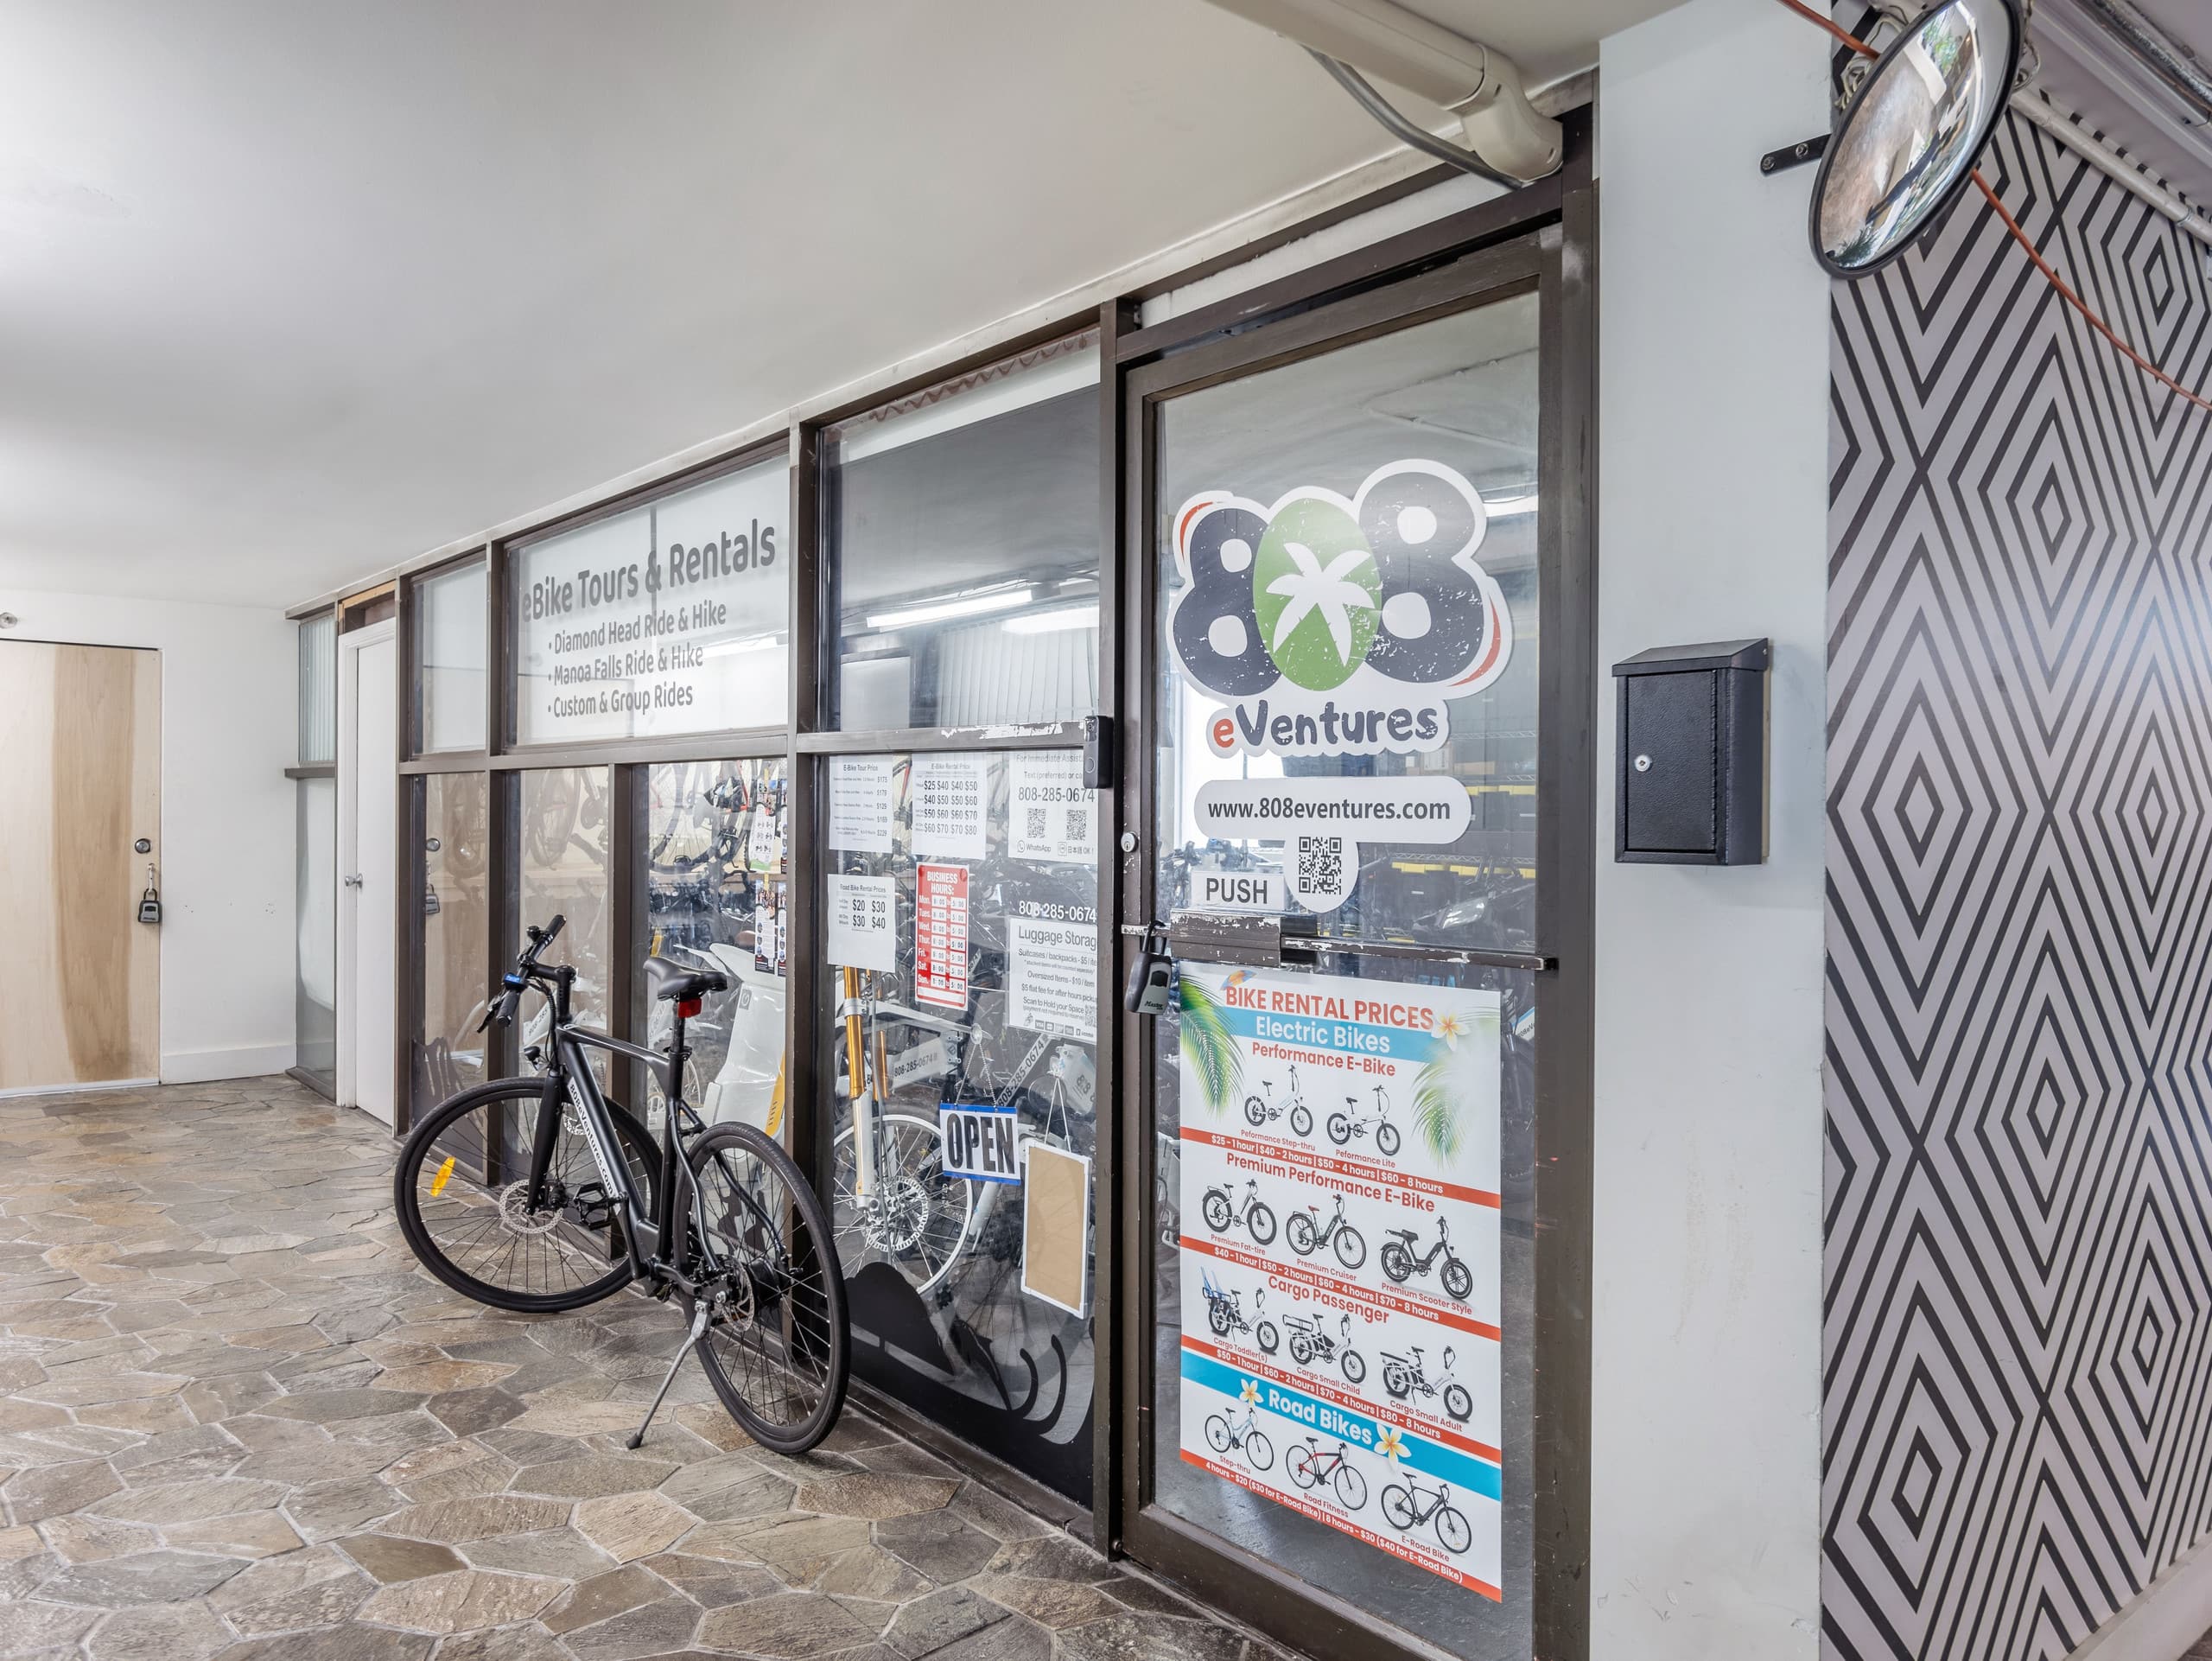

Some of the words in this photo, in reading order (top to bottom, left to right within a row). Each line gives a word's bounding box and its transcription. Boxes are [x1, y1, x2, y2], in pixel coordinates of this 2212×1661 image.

[522, 576, 573, 622] eBike
[578, 563, 639, 608] Tours
[645, 550, 661, 593] &
[669, 519, 775, 588] Rentals
[555, 622, 605, 654] Diamond
[608, 615, 640, 645] Head
[645, 609, 674, 636] Ride
[678, 607, 689, 632] &
[692, 600, 726, 629] Hike
[555, 664, 591, 685] Manoa
[595, 655, 622, 681] Falls
[626, 649, 654, 675] Ride
[658, 648, 667, 671] &
[671, 641, 703, 669] Hike
[553, 694, 595, 717] Custom
[600, 693, 607, 713] &
[612, 690, 649, 716] Group
[655, 681, 693, 710] Rides
[1212, 699, 1439, 748] eVentures
[924, 780, 936, 790] $25
[937, 780, 949, 790] $40
[951, 781, 963, 791] $40
[965, 781, 977, 791] $50
[1019, 787, 1095, 802] 808-285-0674
[924, 795, 936, 805] $40
[937, 795, 949, 805] $50
[951, 795, 963, 805] $50
[965, 796, 977, 805] $60
[1208, 797, 1451, 821] www.808eventures.com
[924, 809, 936, 818] $50
[937, 809, 949, 818] $60
[951, 810, 963, 819] $60
[965, 810, 977, 820] $70
[926, 871, 957, 884] BUSINESS
[931, 882, 954, 895] HOURS:
[1206, 877, 1268, 904] PUSH
[853, 899, 865, 911] $20
[872, 901, 885, 913] $30
[1020, 901, 1096, 922] 808-285-0674
[853, 914, 865, 926] $30
[872, 916, 885, 929] $40
[1019, 926, 1063, 945] Luggage
[1065, 931, 1096, 951] Storag
[1226, 986, 1267, 1010] BIKE
[1272, 991, 1349, 1020] RENTAL
[1355, 1001, 1433, 1030] PRICES
[1256, 1015, 1328, 1045] Electric
[1334, 1026, 1390, 1053] Bikes
[1253, 1042, 1344, 1068] Performance
[1347, 1056, 1395, 1076] E-Bike
[947, 1113, 1015, 1174] OPEN
[1241, 1130, 1279, 1143] Peformance
[1282, 1138, 1315, 1151] Step-thru
[1211, 1135, 1225, 1145] $25
[1236, 1141, 1255, 1152] hour
[1260, 1146, 1274, 1155] $40
[1288, 1151, 1313, 1163] hours
[1318, 1158, 1334, 1168] $50
[1343, 1163, 1348, 1172] 4
[1350, 1164, 1375, 1178] hours
[1382, 1172, 1399, 1183] $60
[1408, 1177, 1414, 1187] 8
[1415, 1178, 1443, 1193] hours
[1335, 1149, 1381, 1165] Peformance
[1382, 1159, 1395, 1168] Lite
[1227, 1153, 1285, 1178] Premium
[1289, 1167, 1382, 1200] Performance
[1385, 1188, 1434, 1212] E-Bike
[1211, 1234, 1240, 1248] Premium
[1241, 1241, 1266, 1255] Fat-tire
[1297, 1258, 1329, 1273] Premium
[1331, 1268, 1357, 1281] Cruiser
[1215, 1247, 1229, 1257] $40
[1240, 1253, 1257, 1266] hour
[1262, 1261, 1276, 1271] $50
[1284, 1267, 1289, 1276] 2
[1290, 1269, 1313, 1282] hours
[1319, 1277, 1334, 1289] $60
[1342, 1284, 1348, 1294] 4
[1350, 1285, 1374, 1301] hours
[1381, 1295, 1395, 1308] $70
[1404, 1302, 1410, 1312] 8
[1412, 1303, 1439, 1321] hours
[1268, 1276, 1310, 1301] Cargo
[1313, 1288, 1389, 1323] Passenger
[1382, 1282, 1417, 1299] Premium
[1418, 1293, 1449, 1308] Scooter
[1451, 1302, 1472, 1315] Style
[1214, 1337, 1233, 1349] Cargo
[1234, 1344, 1268, 1363] Toddler(s)
[1217, 1349, 1230, 1360] $50
[1242, 1358, 1259, 1371] hour
[1264, 1367, 1279, 1378] $60
[1286, 1374, 1291, 1383] 2
[1292, 1376, 1314, 1391] hours
[1320, 1387, 1335, 1398] $70
[1343, 1396, 1349, 1404] 4
[1351, 1397, 1375, 1414] hours
[1381, 1410, 1397, 1422] $80
[1406, 1418, 1412, 1428] 8
[1414, 1421, 1440, 1439] hours
[1297, 1366, 1318, 1380] Cargo
[1319, 1375, 1339, 1387] Small
[1341, 1383, 1360, 1395] Child
[1269, 1389, 1315, 1423] Road
[1320, 1408, 1372, 1444] Bikes
[1390, 1400, 1414, 1415] Cargo
[1415, 1410, 1438, 1423] Small
[1440, 1418, 1463, 1432] Adult
[1220, 1456, 1250, 1473] Step-thru
[1304, 1493, 1321, 1505] Road
[1324, 1501, 1348, 1518] Fitness
[1211, 1463, 1230, 1477] hours
[1236, 1474, 1248, 1486] $20
[1249, 1480, 1264, 1492] ($30
[1265, 1488, 1274, 1498] for
[1276, 1492, 1301, 1510] E-Road
[1303, 1504, 1320, 1519] Bike)
[1325, 1513, 1330, 1522] 8
[1332, 1518, 1353, 1532] hours
[1361, 1530, 1375, 1542] $30
[1376, 1536, 1395, 1551] ($40
[1396, 1547, 1408, 1556] for
[1409, 1551, 1440, 1571] E-Road
[1441, 1565, 1463, 1583] Bike)
[1402, 1536, 1430, 1553] E-Road
[1433, 1548, 1449, 1562] Bike
